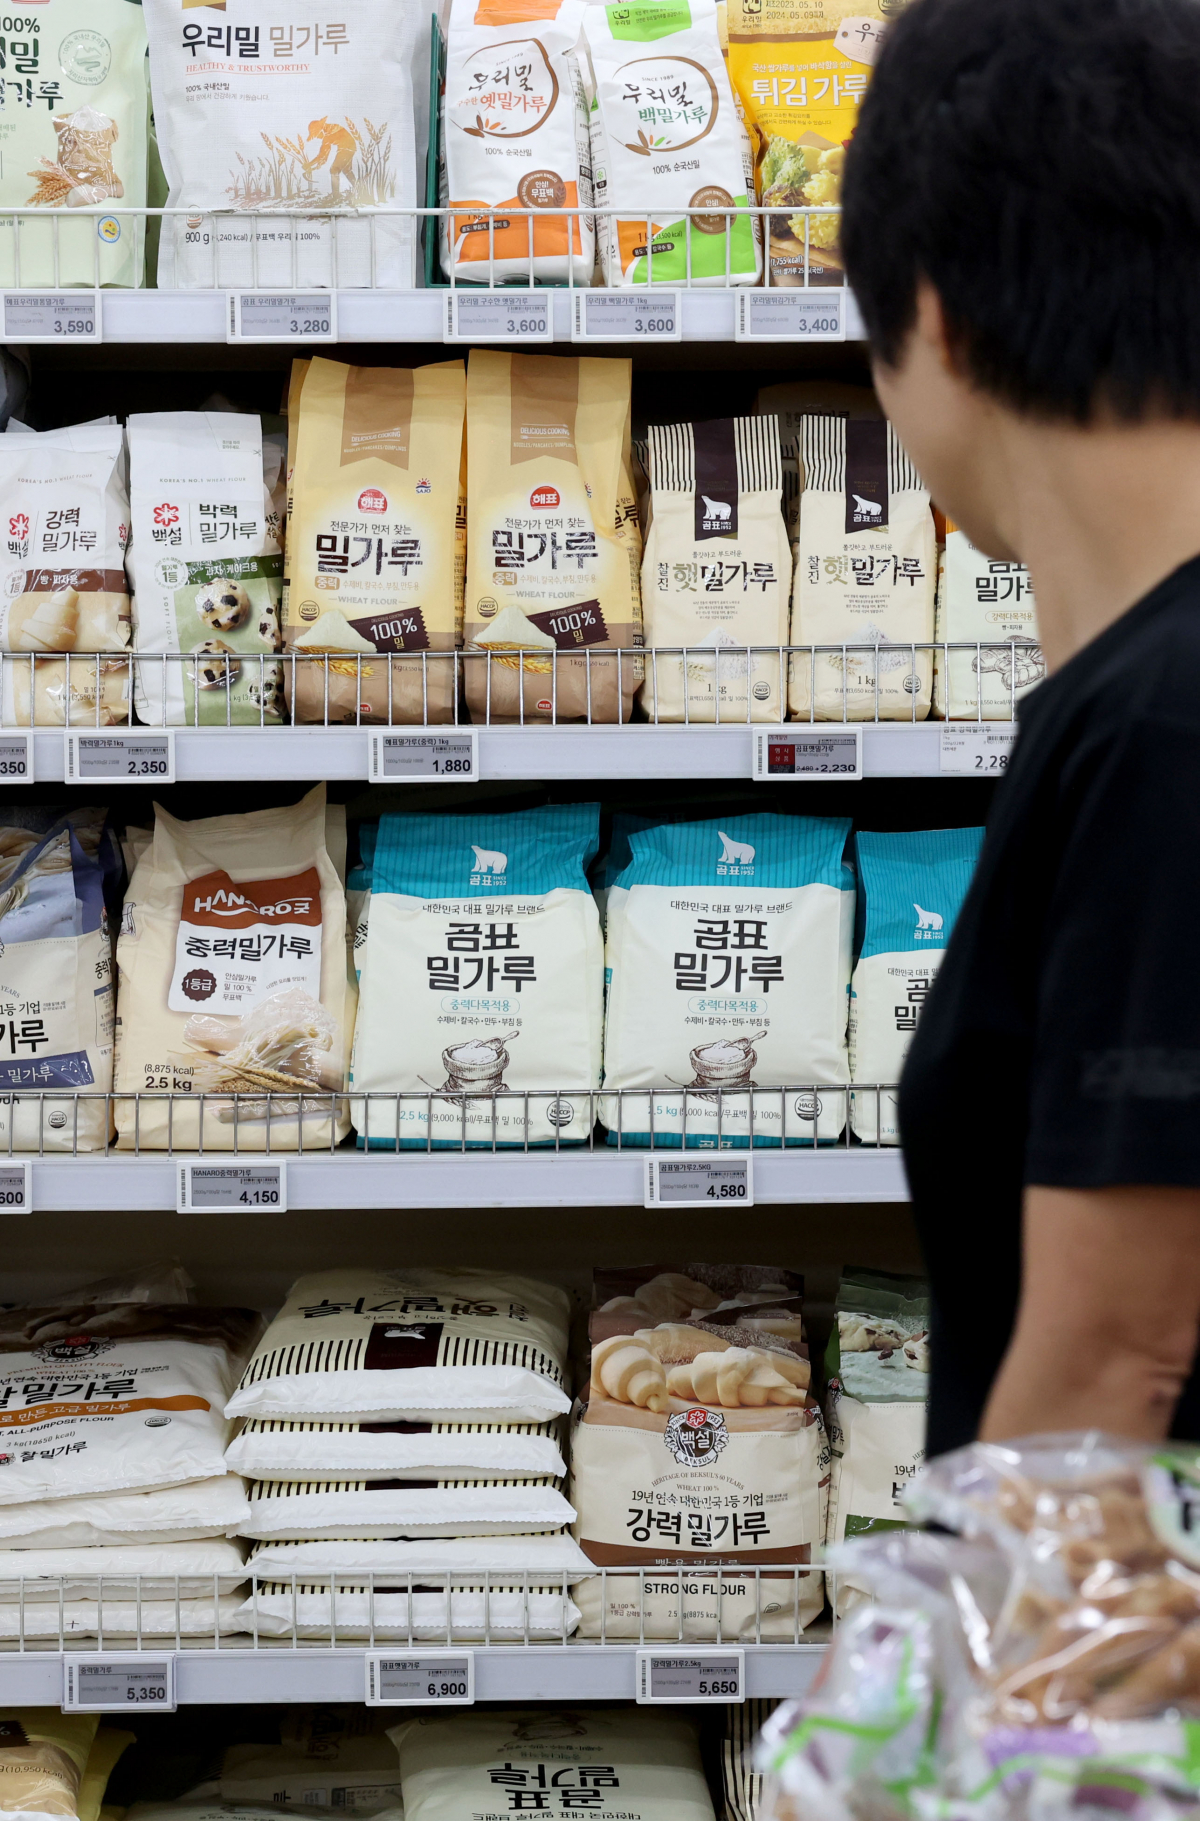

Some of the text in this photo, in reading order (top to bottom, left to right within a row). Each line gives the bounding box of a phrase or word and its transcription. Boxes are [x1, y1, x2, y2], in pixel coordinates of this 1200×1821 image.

[182, 23, 350, 57] 우리밀 밀가루
[186, 62, 226, 72] HEALTHY
[237, 64, 310, 72] TRUSTWORTHY
[752, 63, 766, 73] 국산
[468, 64, 534, 92] 우리밀
[622, 81, 694, 107] 우리밀
[750, 74, 868, 106] 튀김 가루
[480, 90, 547, 114] 옛밀가루
[638, 105, 708, 125] 백밀가루
[484, 148, 532, 156] 100% 순국산밀
[652, 160, 700, 175] 100% 순국산밀
[186, 232, 200, 243] 900
[54, 320, 94, 336] 3,590
[290, 320, 330, 335] 3,280
[506, 319, 546, 334] 3,600
[634, 318, 674, 334] 3,600
[798, 318, 838, 333] 3,400
[520, 427, 546, 436] DELICIOUS
[360, 496, 384, 509] 해표
[532, 493, 558, 505] 해표
[46, 507, 80, 530] 강력
[199, 504, 238, 519] 박력
[852, 514, 871, 522] 곰표
[330, 520, 412, 535] 전문가가 먼저 찾는
[504, 518, 586, 530] 전문가가 먼저 찾는
[702, 521, 721, 530] 곰표
[152, 528, 182, 546] 백설
[200, 522, 258, 544] 밀가루
[42, 530, 97, 552] 밀가루
[868, 544, 893, 552] 부드러운
[316, 534, 423, 576] 밀가루
[492, 530, 598, 570] 밀가루
[718, 550, 742, 558] 부드러운
[162, 571, 178, 583] 1등
[316, 577, 337, 588] 중력
[494, 573, 515, 584] 중력
[338, 596, 368, 604] WHEAT
[548, 610, 596, 634] 100%
[370, 618, 418, 641] 100%
[573, 629, 584, 643] 밀
[394, 636, 405, 650] 밀
[128, 760, 166, 776] 2,350
[432, 760, 471, 774] 1,880
[820, 764, 856, 774] 2,230
[974, 754, 1008, 772] 2,28
[716, 864, 740, 875] 곰표
[470, 874, 492, 886] 곰표
[422, 904, 546, 915] 대한민국 대표 밀가루 브랜드
[670, 900, 793, 914] 대한민국 대표 밀가루 브랜드
[445, 922, 520, 952] 곰표
[694, 918, 768, 950] 곰표
[914, 930, 932, 940] 곰표
[185, 934, 314, 962] 중력밀가루
[225, 972, 257, 982] 안심밀가루
[427, 956, 536, 992] 밀가루
[674, 952, 784, 994] 밀가루
[888, 968, 929, 976] 대한민국 대표
[0, 985, 21, 998] YEARS
[185, 978, 212, 992] 1등급
[18, 1001, 40, 1014] 기업
[450, 999, 511, 1012] 중력다목적용
[697, 1000, 759, 1013] 중력다목적용
[516, 1018, 522, 1026] 등
[8, 1066, 53, 1083] 밀가루
[144, 1064, 194, 1076] (8,875 kcal)
[145, 1076, 192, 1091] 2.5 kg
[400, 1110, 429, 1122] 2.5 kg
[666, 1106, 678, 1117] kg
[760, 1110, 782, 1120] 100%
[240, 1190, 278, 1206] 4,150
[706, 1184, 746, 1200] 4,580
[54, 1345, 92, 1356] 백설
[41, 1374, 92, 1382] 대한민국
[114, 1368, 138, 1376] 기업
[18, 1403, 132, 1422] 만든 고급 밀가루
[707, 1414, 720, 1425] 1953
[6, 1416, 78, 1436] ALL-PURPOSE
[55, 1430, 76, 1440] kcal)
[681, 1430, 710, 1450] 백설
[894, 1464, 916, 1478] 19년
[651, 1473, 678, 1488] HERITAGE
[726, 1476, 745, 1490] YEARS
[676, 1484, 700, 1492] WHEAT
[632, 1490, 654, 1503] 19년
[680, 1494, 722, 1510] 대한민국
[724, 1496, 740, 1508] 1등
[742, 1493, 764, 1508] 기업
[644, 1583, 746, 1596] STRONG FLOUR
[126, 1687, 166, 1702] 5,350
[428, 1682, 466, 1698] 6,900
[699, 1681, 738, 1696] 5,650
[487, 1763, 620, 1788] 밀가루
[505, 1789, 604, 1810] 곰표
